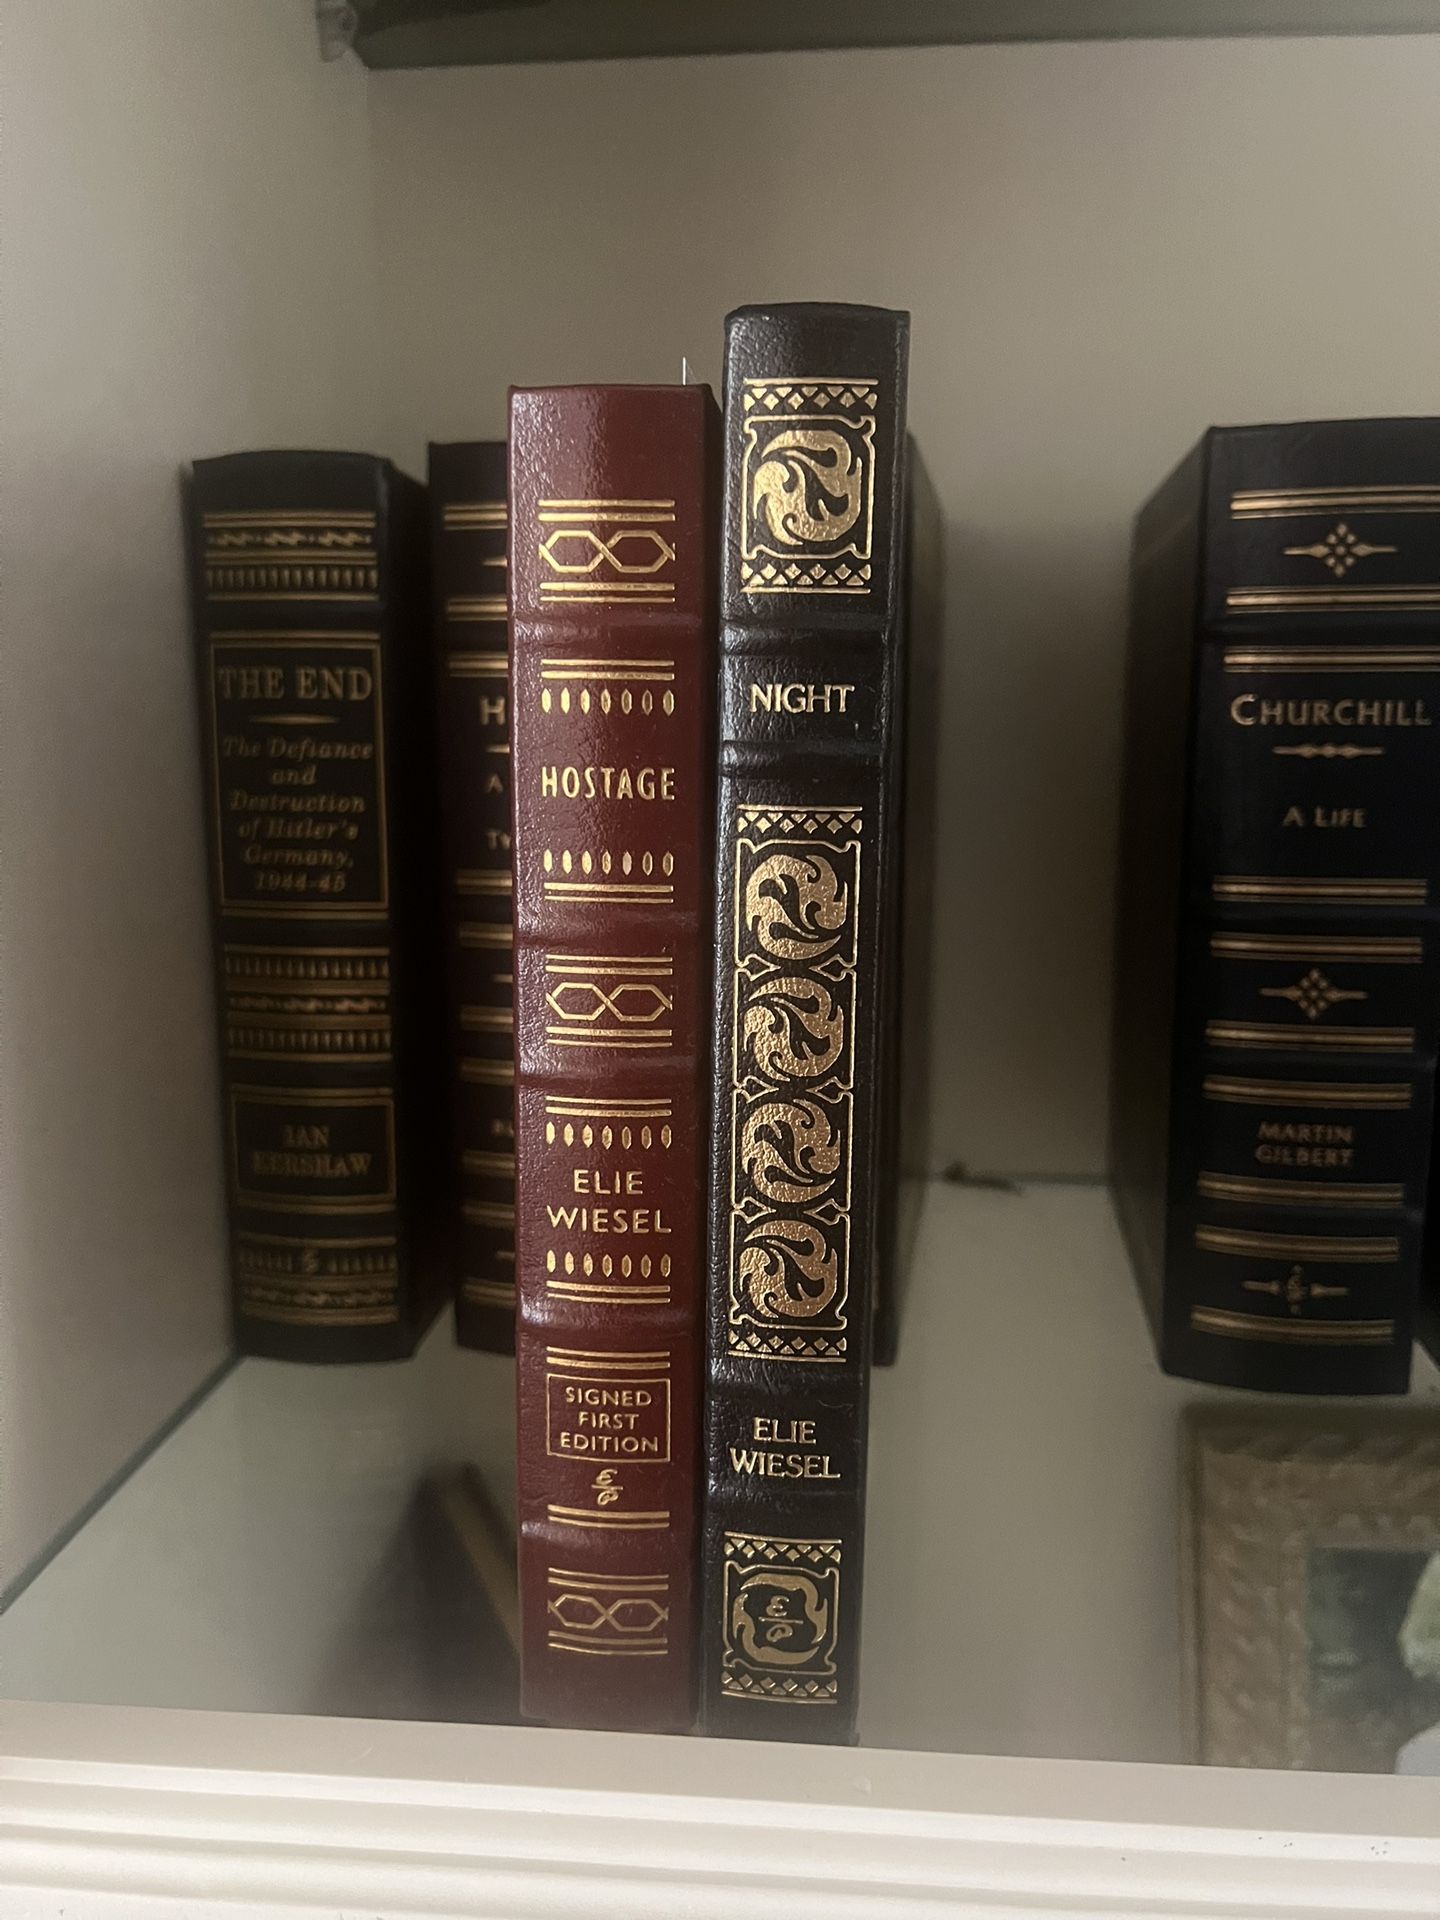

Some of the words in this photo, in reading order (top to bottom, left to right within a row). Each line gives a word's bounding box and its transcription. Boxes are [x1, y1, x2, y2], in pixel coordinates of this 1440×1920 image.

[217, 665, 285, 699] THE
[300, 664, 373, 701] END
[750, 683, 855, 714] NIGHT
[223, 736, 262, 759] The
[270, 737, 374, 762] Defiance
[271, 765, 317, 786] and
[541, 767, 675, 801] HOSTAGE
[230, 790, 366, 813] Destruction
[238, 817, 262, 841] of
[1283, 806, 1303, 828] A
[244, 843, 354, 869] Germany,
[283, 1124, 329, 1147] IAN
[1257, 1122, 1354, 1143] MARTIN
[1256, 1144, 1354, 1167] GILBERT
[573, 1168, 644, 1195] ELIE
[546, 1205, 672, 1234] WIESEL
[565, 1387, 652, 1406] SIGNED
[578, 1411, 640, 1428] FIRST
[753, 1416, 817, 1445] ELIE
[560, 1432, 658, 1452] EDITION
[729, 1447, 841, 1479] WIESEL
